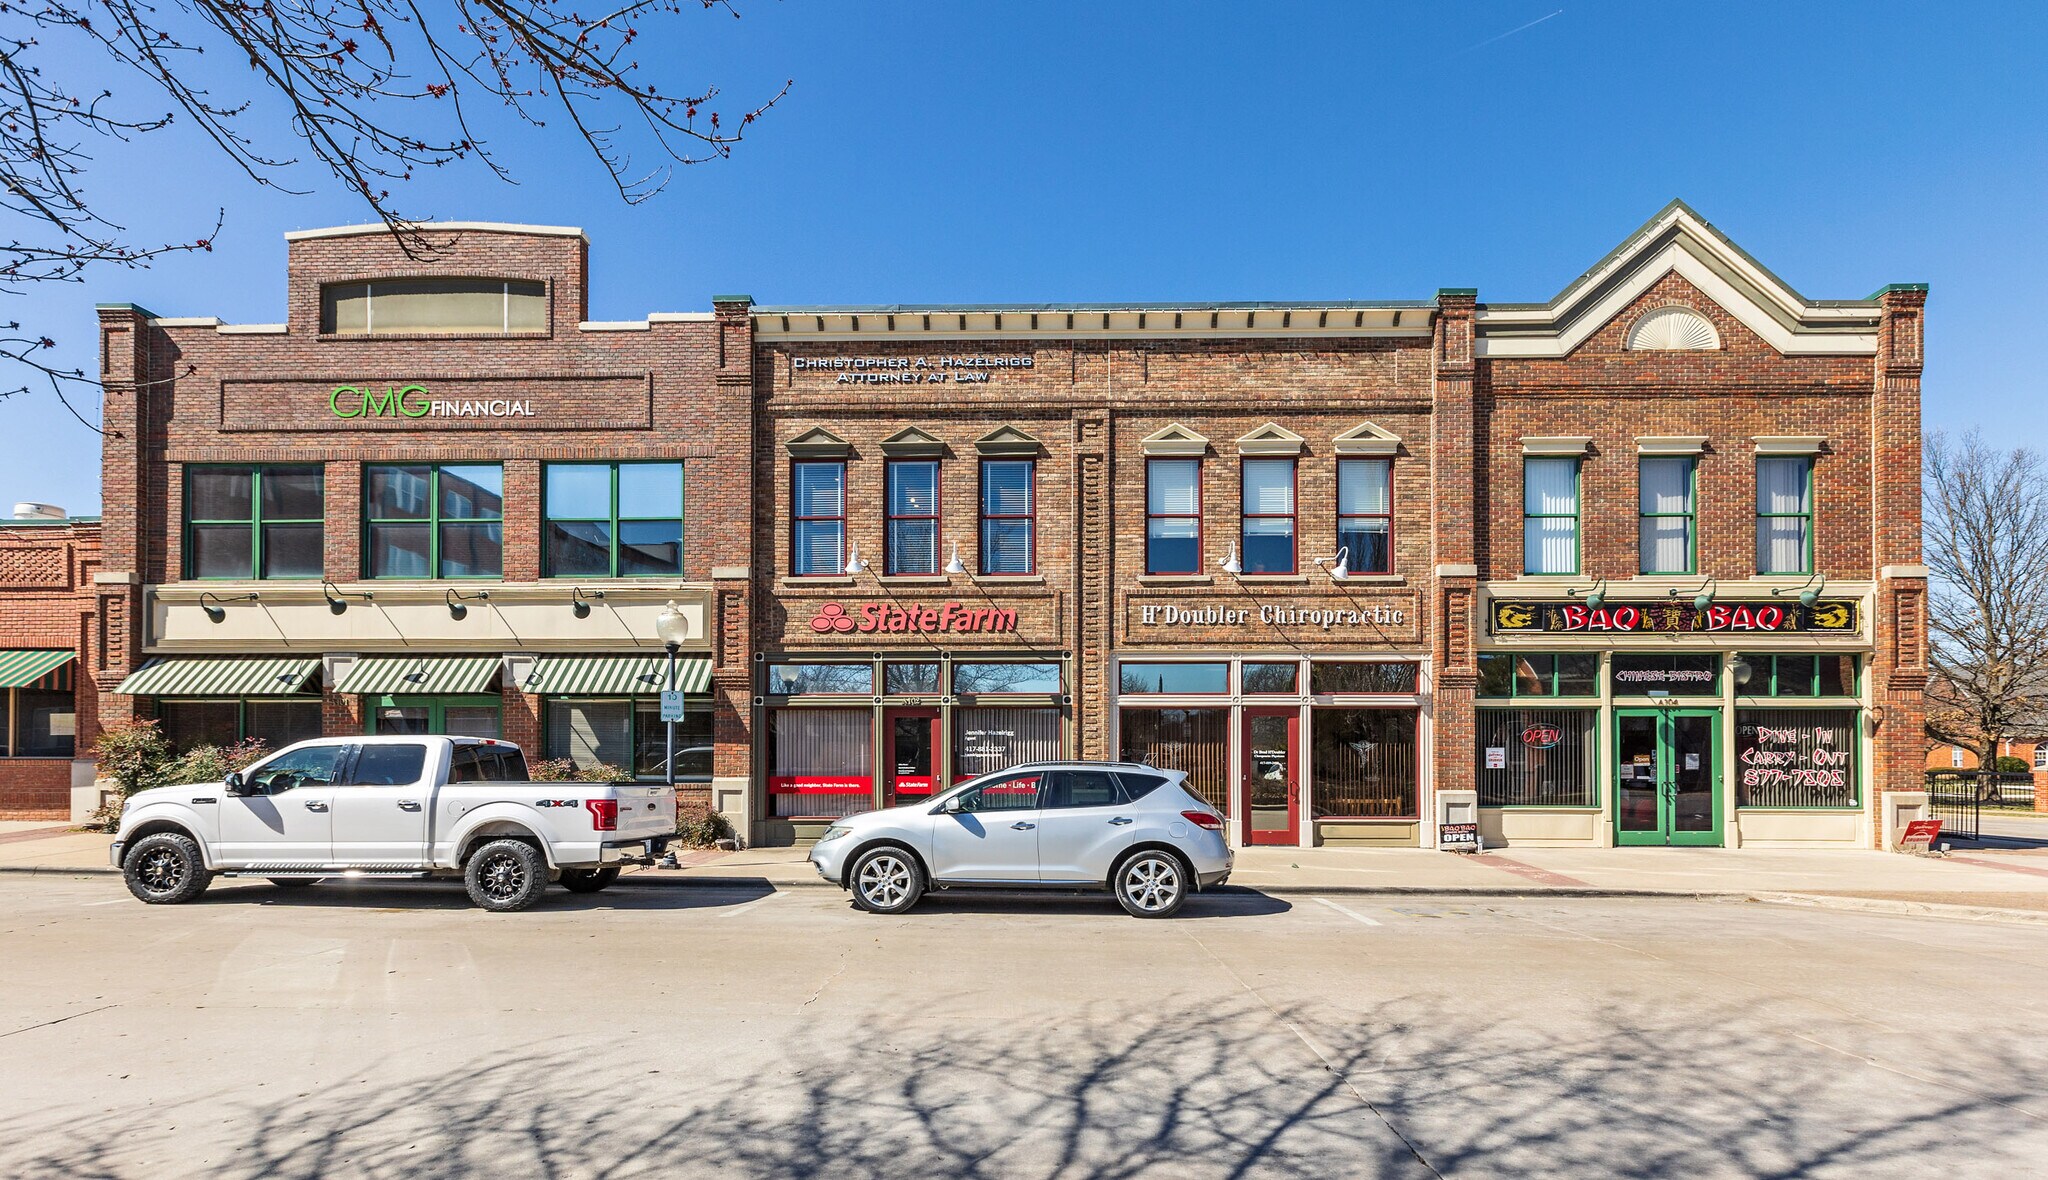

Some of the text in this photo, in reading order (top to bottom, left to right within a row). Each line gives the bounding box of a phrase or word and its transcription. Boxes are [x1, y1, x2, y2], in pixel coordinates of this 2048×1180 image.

[794, 357, 1033, 368] CHRISTOPHER A. HAZELRIGG
[837, 372, 990, 383] ATTORNEY AT LAW
[329, 384, 535, 418] CMG FINANCIAL
[1141, 605, 1404, 629] H'Doubler Chiropractic
[1562, 605, 1640, 631] BAO
[1705, 605, 1783, 631] BAO
[1616, 670, 1712, 682] CHINESE BISTRO
[1523, 729, 1560, 743] OPEN
[1741, 747, 1796, 766] CARRY
[1813, 748, 1849, 766] OUT
[1443, 833, 1475, 842] OPEN
